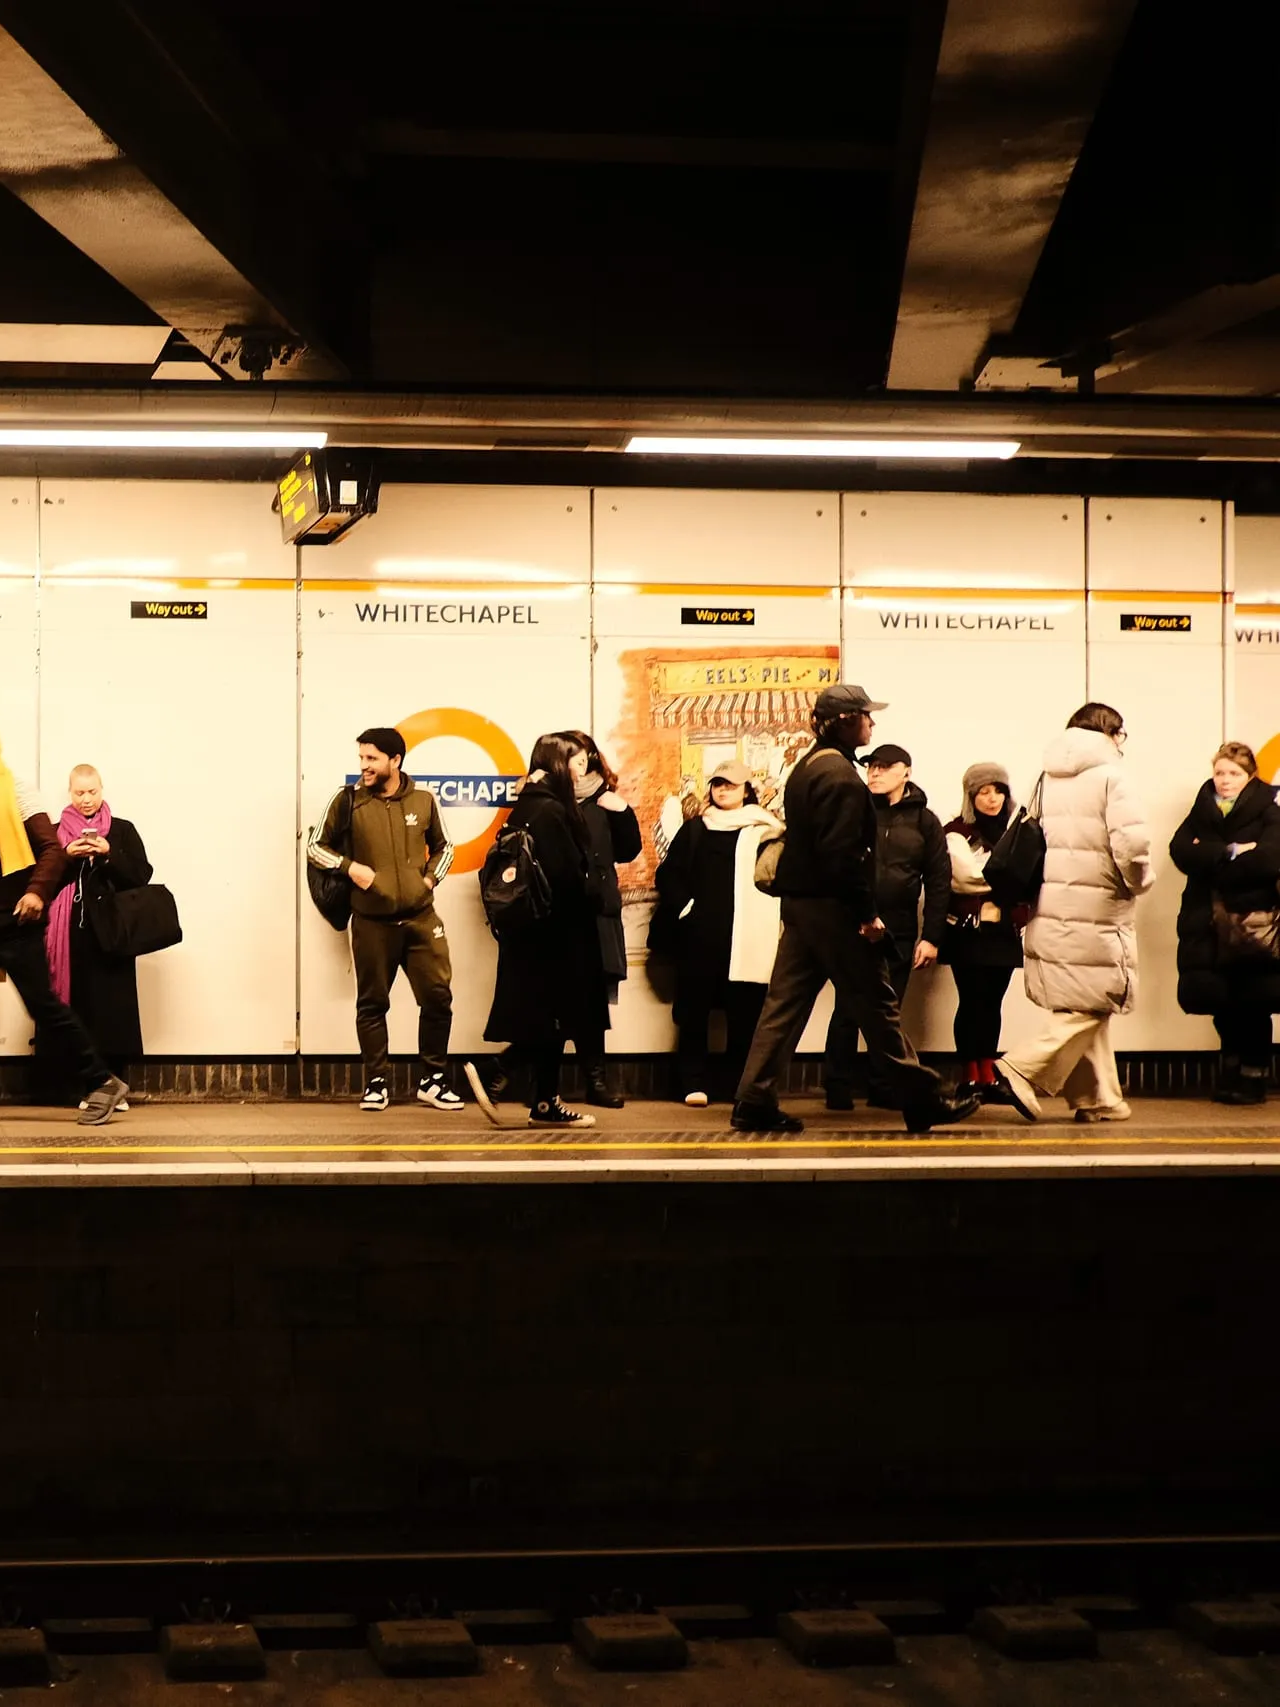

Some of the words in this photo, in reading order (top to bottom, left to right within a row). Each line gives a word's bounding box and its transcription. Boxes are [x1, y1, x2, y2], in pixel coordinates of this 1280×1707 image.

[145, 602, 171, 617] Way
[172, 604, 193, 615] out
[355, 603, 539, 624] WHITECHAPEL
[695, 609, 719, 623] Way
[720, 611, 740, 621] out
[1134, 615, 1158, 629] Way
[1158, 617, 1177, 628] out
[705, 667, 748, 685] EELS
[761, 667, 791, 683] PIE
